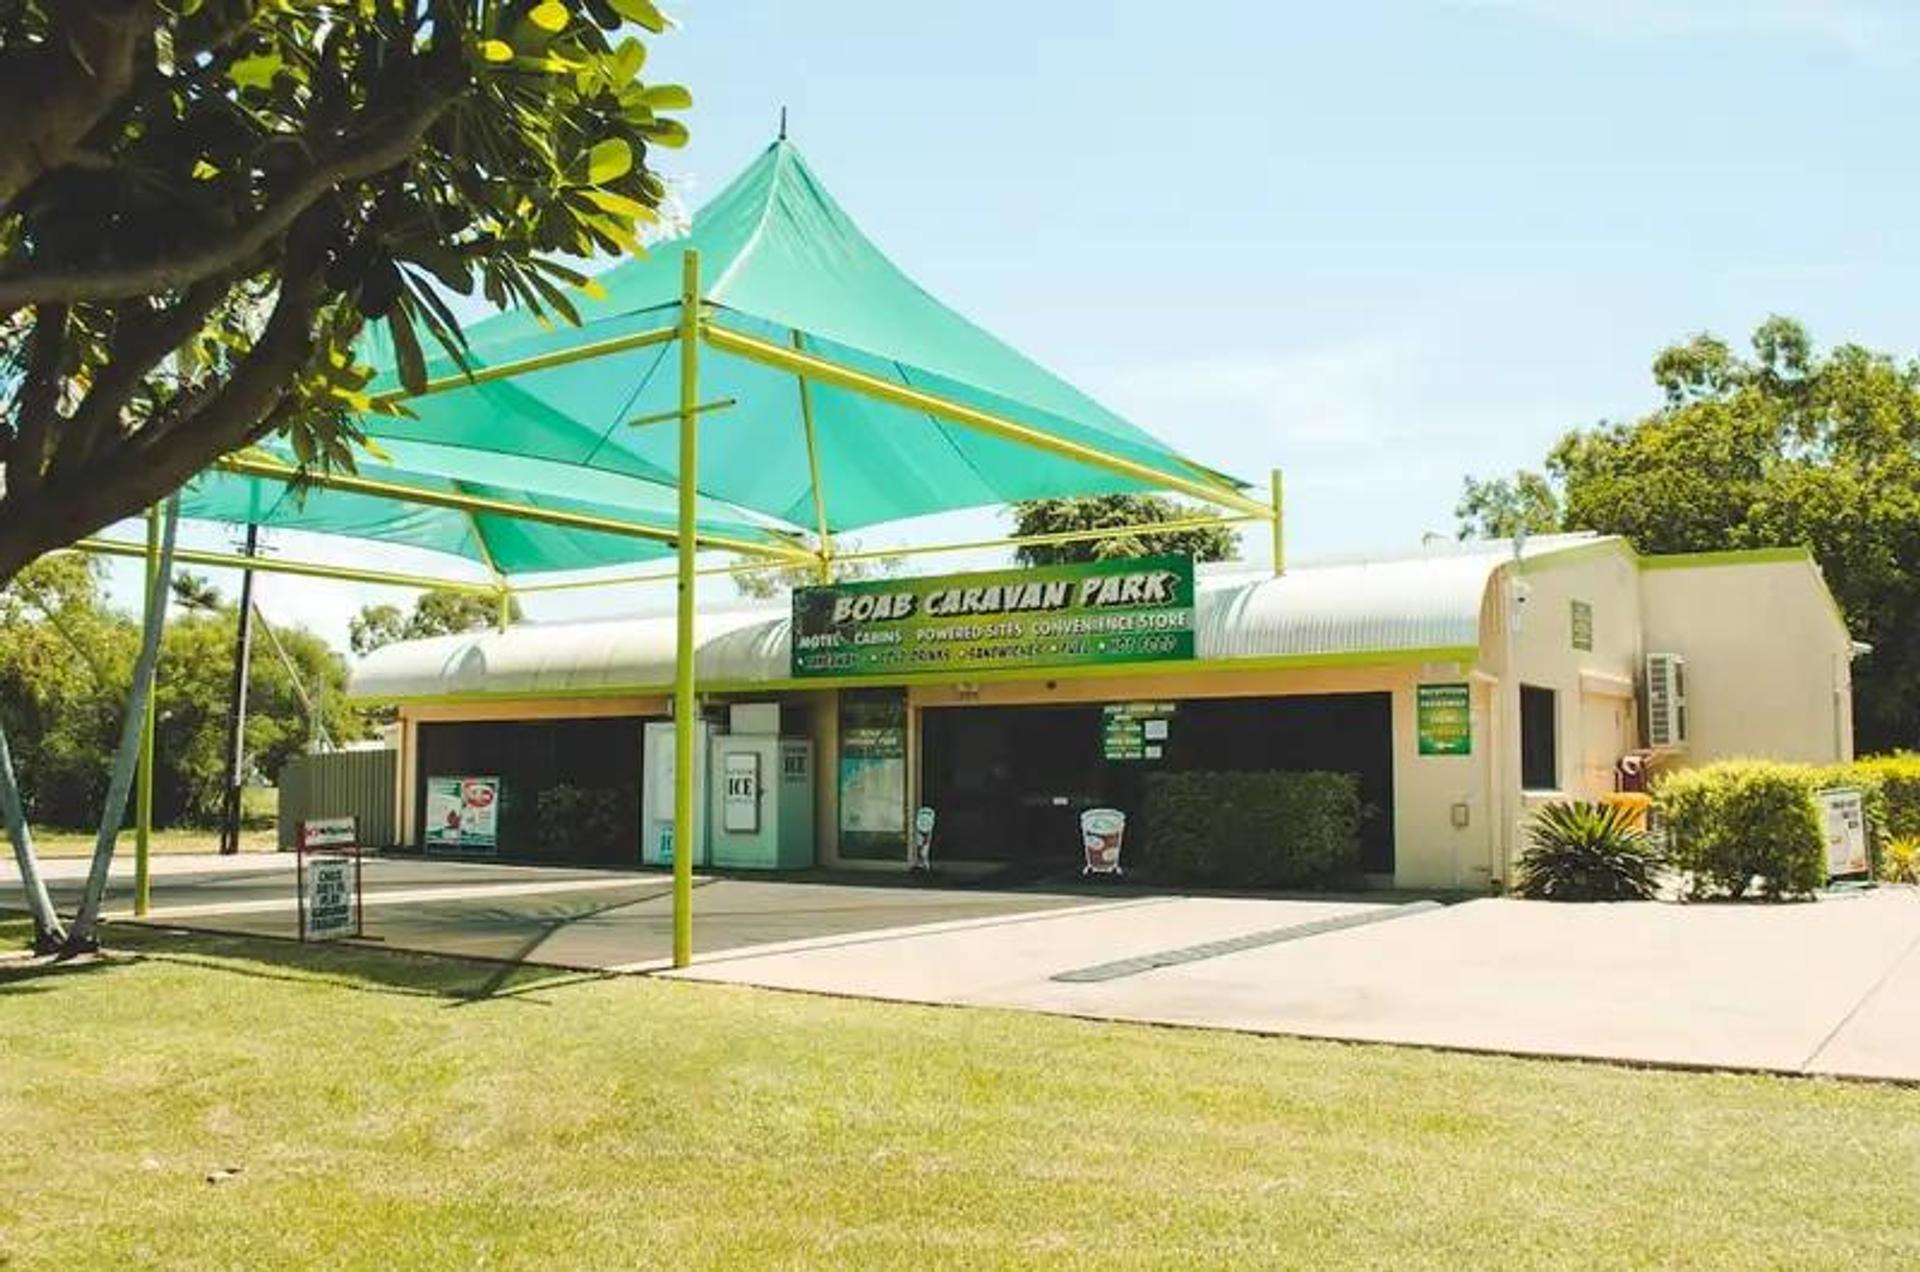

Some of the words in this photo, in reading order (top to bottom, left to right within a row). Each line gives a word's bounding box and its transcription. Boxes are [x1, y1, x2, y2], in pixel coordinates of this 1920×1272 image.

[832, 593, 915, 623] BOAB
[924, 581, 1072, 617] CARAVAN
[1080, 571, 1174, 606] PARK
[798, 632, 841, 649] MOTEL
[854, 630, 903, 646] CABINS
[917, 625, 982, 643] POWERED
[986, 622, 1023, 639] SITES
[1034, 616, 1135, 638] CONVENIENCE
[1138, 612, 1187, 630] STORE
[729, 778, 752, 796] ICE
